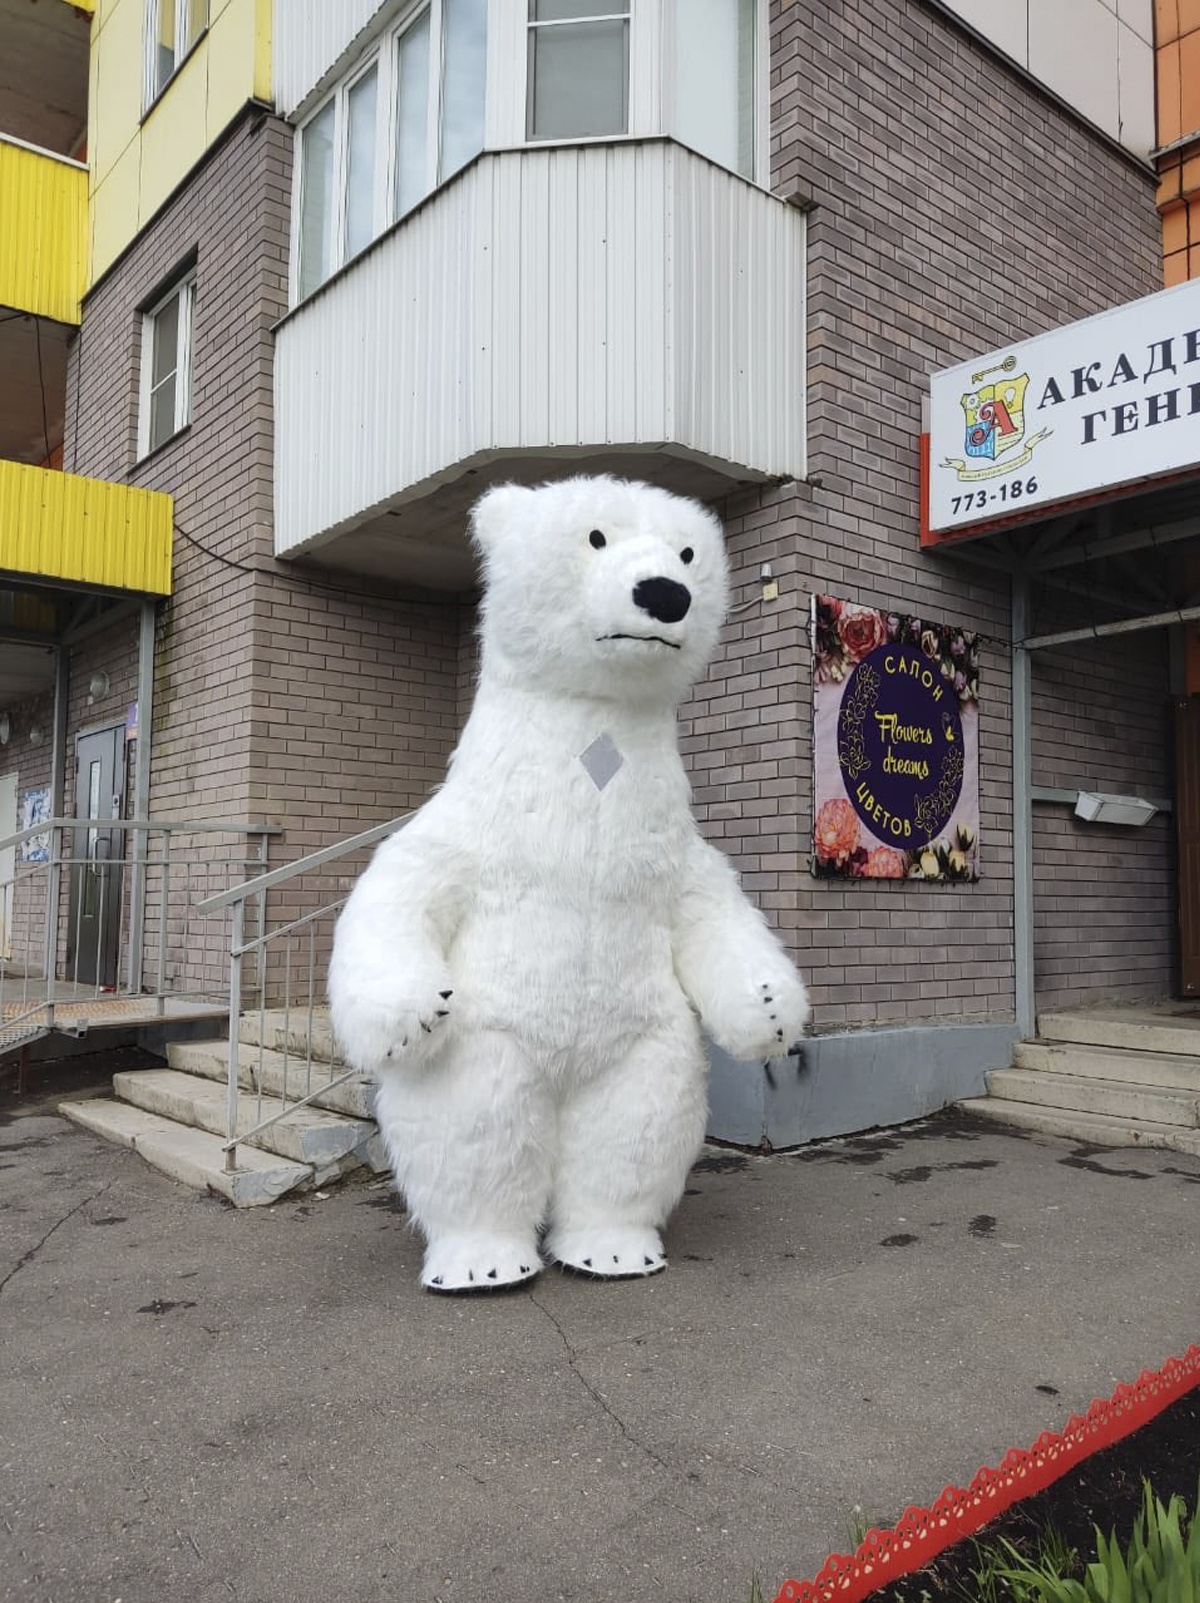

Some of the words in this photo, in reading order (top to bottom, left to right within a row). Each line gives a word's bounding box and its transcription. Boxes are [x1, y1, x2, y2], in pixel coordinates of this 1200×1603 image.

[951, 476, 1038, 515] 773-186
[885, 656, 943, 702] САЛОН
[875, 711, 933, 745] Flowers
[883, 745, 929, 780] dreams
[856, 782, 912, 838] ЦВЕТОВ
